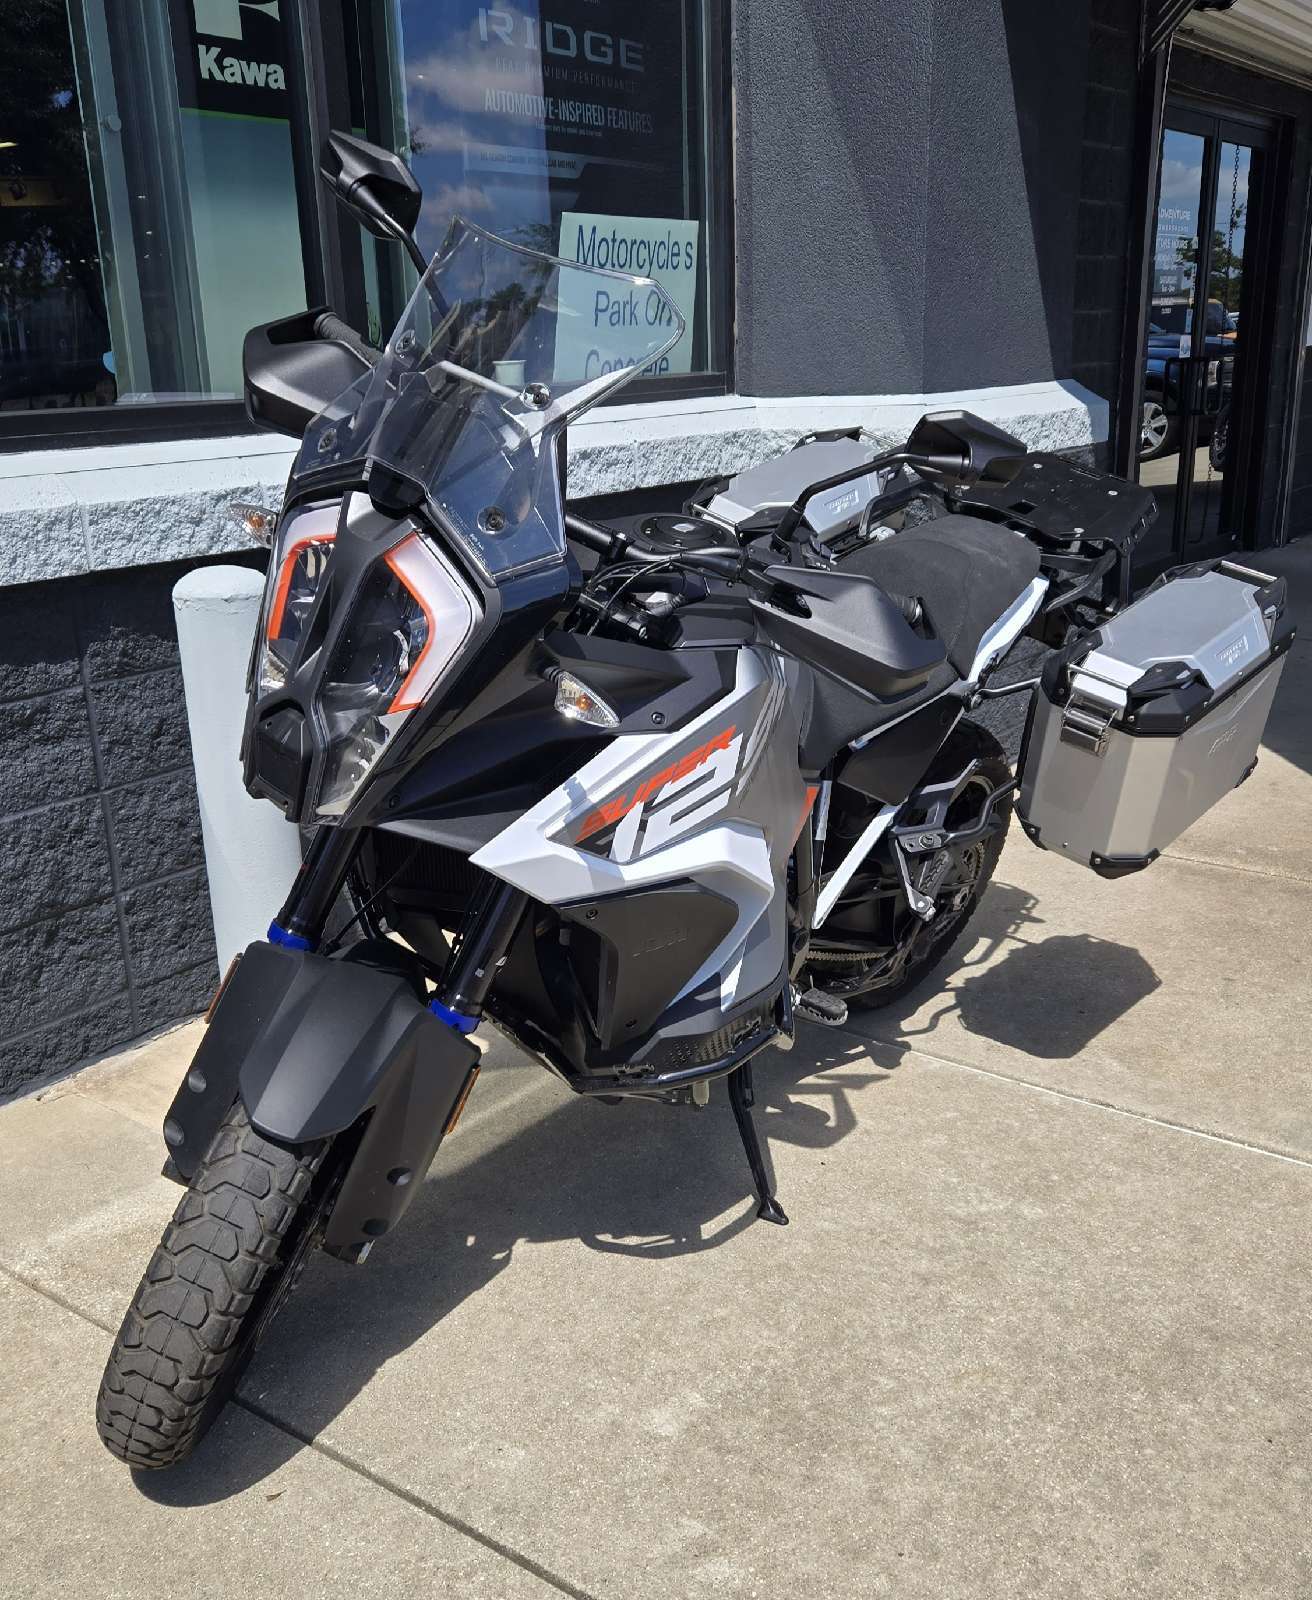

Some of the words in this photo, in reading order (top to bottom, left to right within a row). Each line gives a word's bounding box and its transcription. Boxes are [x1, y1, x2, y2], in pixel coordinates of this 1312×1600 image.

[478, 7, 645, 72] RIDGE
[197, 43, 287, 90] Kawa
[484, 87, 605, 127] AUTOMOTIVE-INSPIRED
[606, 108, 653, 134] FEATURES
[576, 223, 694, 278] Motorcycles
[594, 288, 639, 328] Park
[644, 289, 673, 327] On
[574, 724, 737, 843] SUPER
